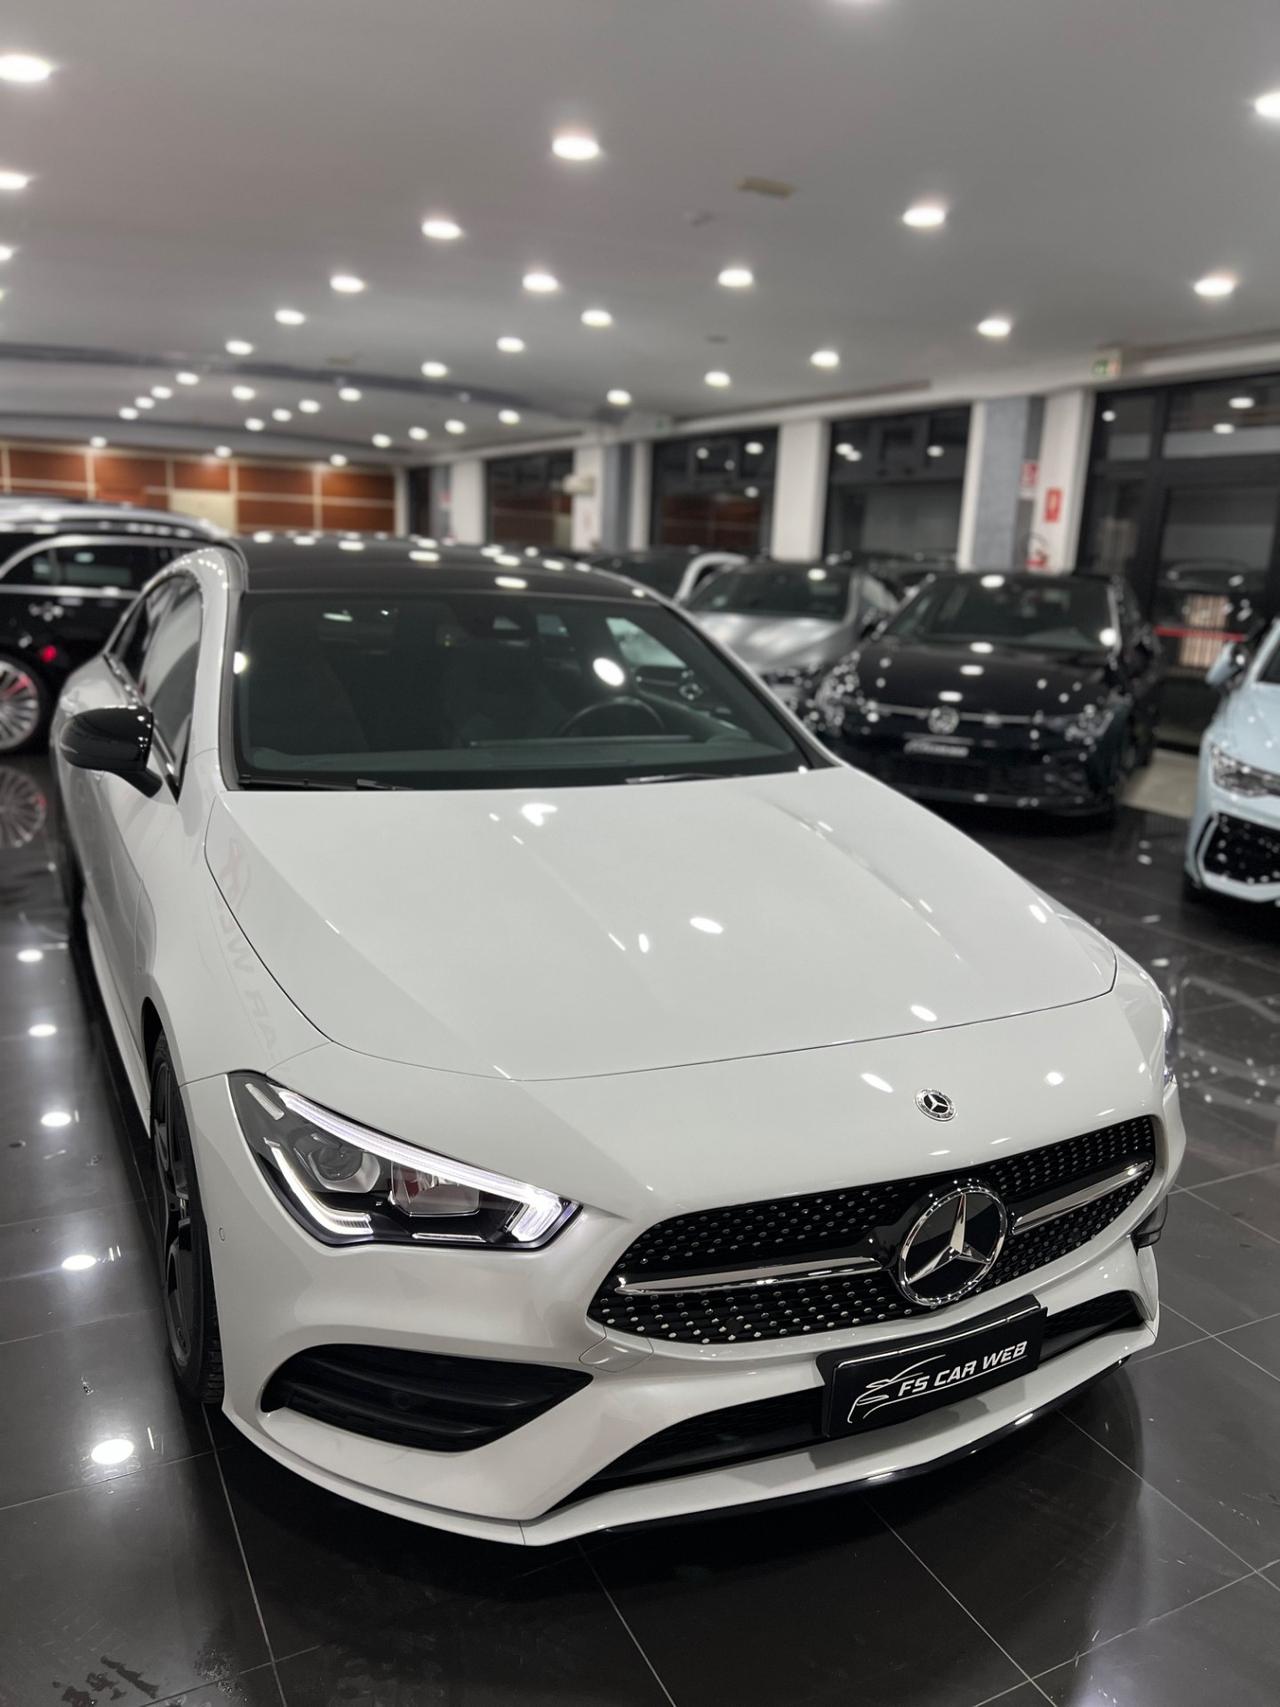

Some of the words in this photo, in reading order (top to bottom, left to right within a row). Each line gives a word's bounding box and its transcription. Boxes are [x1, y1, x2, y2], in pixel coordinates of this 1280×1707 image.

[898, 1375, 930, 1397] FS
[933, 1360, 978, 1387] CAR
[982, 1340, 1028, 1370] WEB
